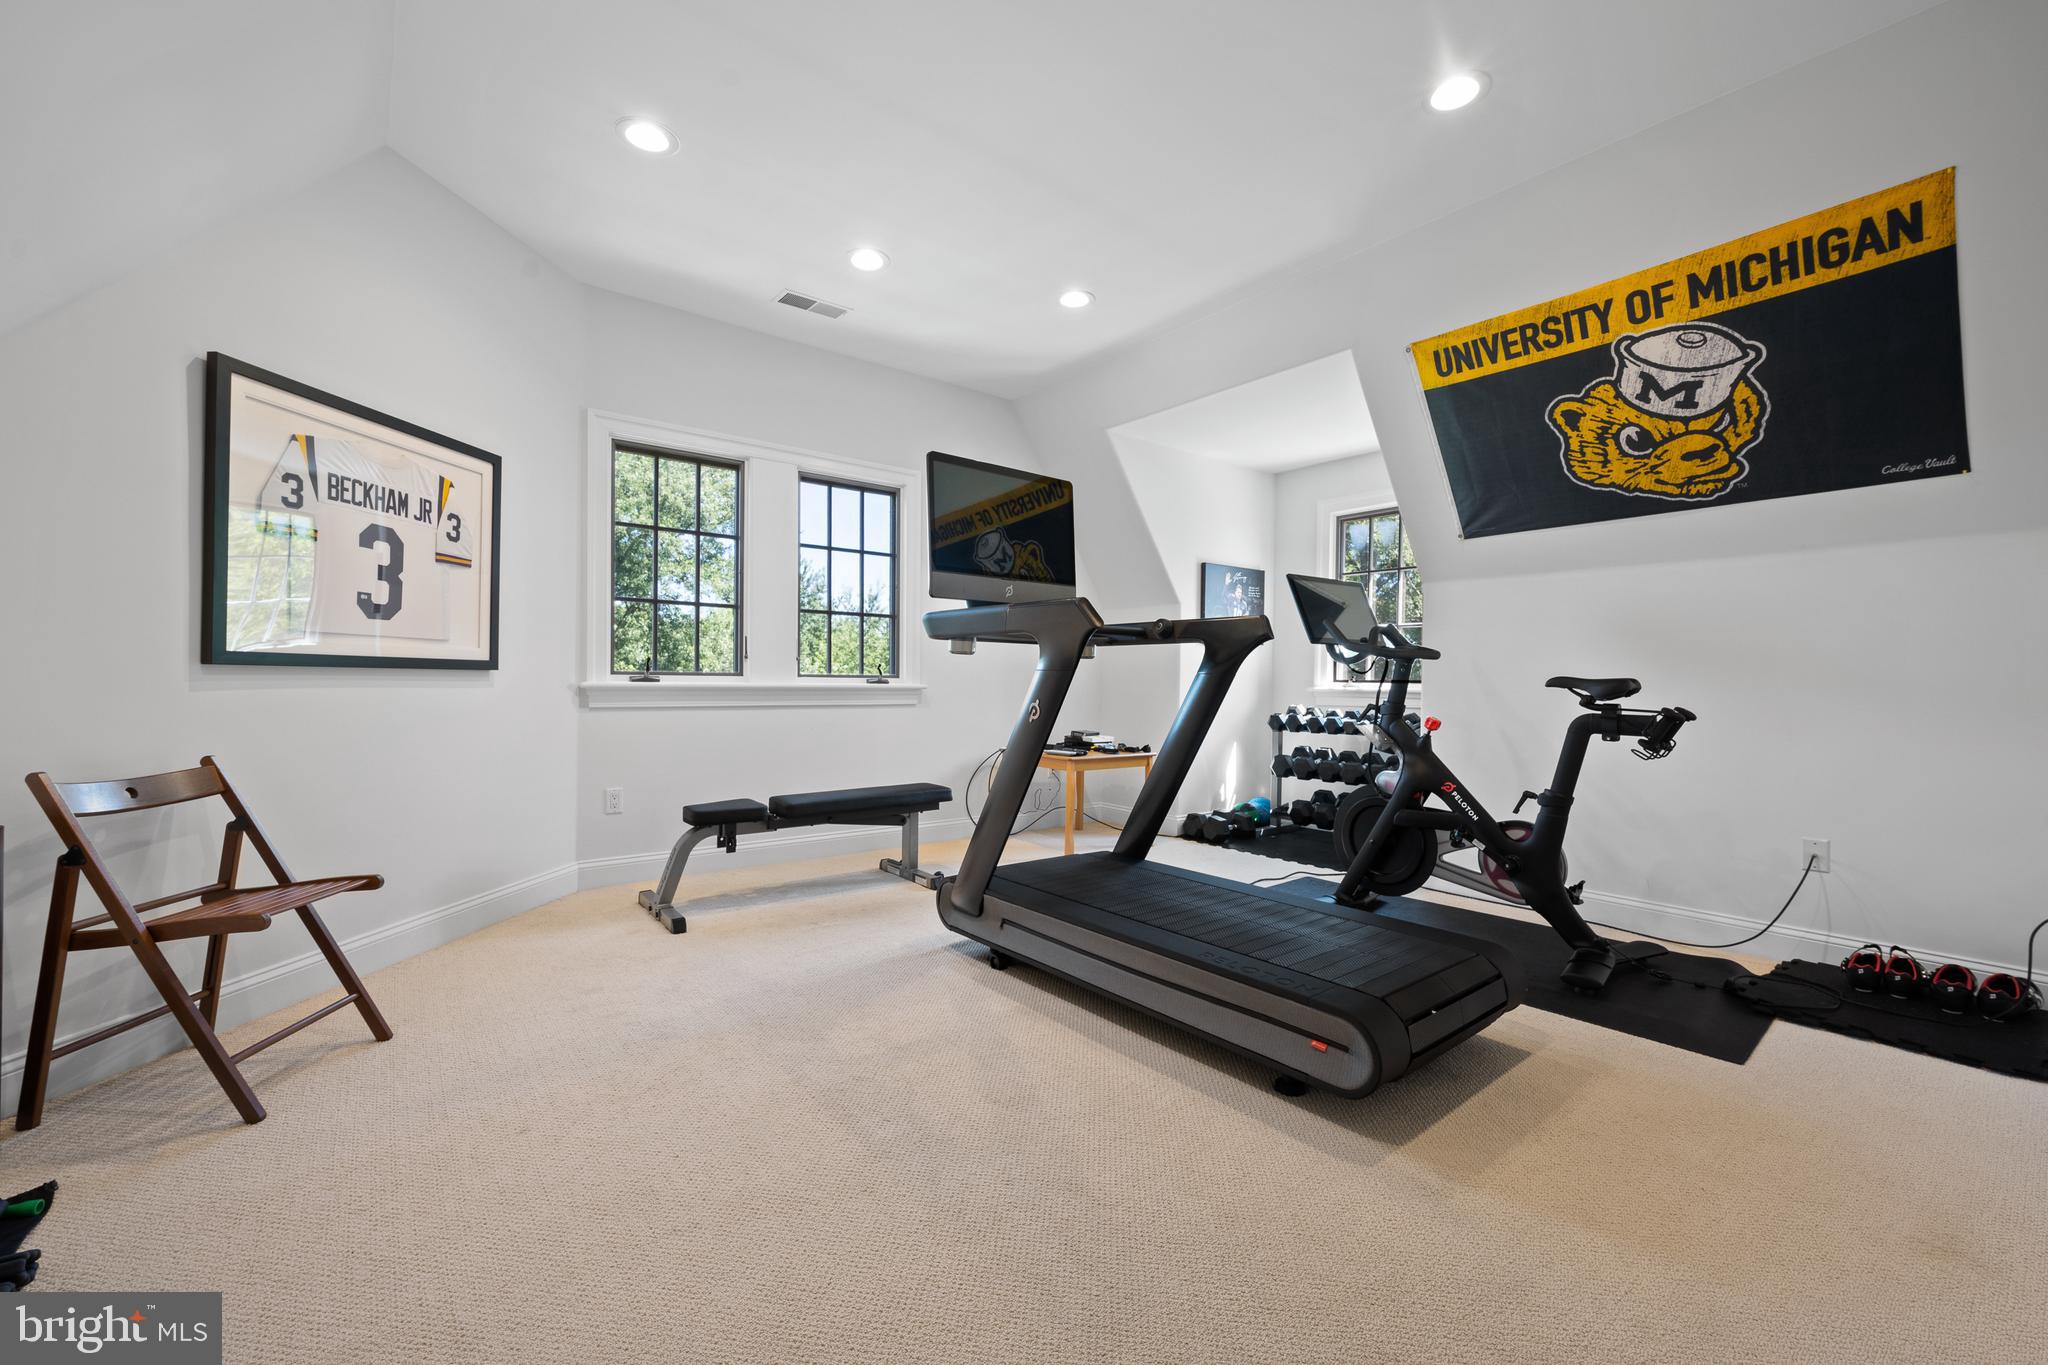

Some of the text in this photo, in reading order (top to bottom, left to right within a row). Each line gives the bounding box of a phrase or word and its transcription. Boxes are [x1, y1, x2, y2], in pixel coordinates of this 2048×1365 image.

[1433, 200, 1924, 377] UNIVERSITY OF MICHIGAN
[1638, 371, 1704, 410] M
[1881, 454, 1957, 474] College Vault
[281, 472, 304, 510] 3
[327, 472, 432, 525] BECKHAM JR
[446, 513, 461, 543] 3
[358, 523, 404, 620] 3
[1451, 791, 1479, 821] PELOTON
